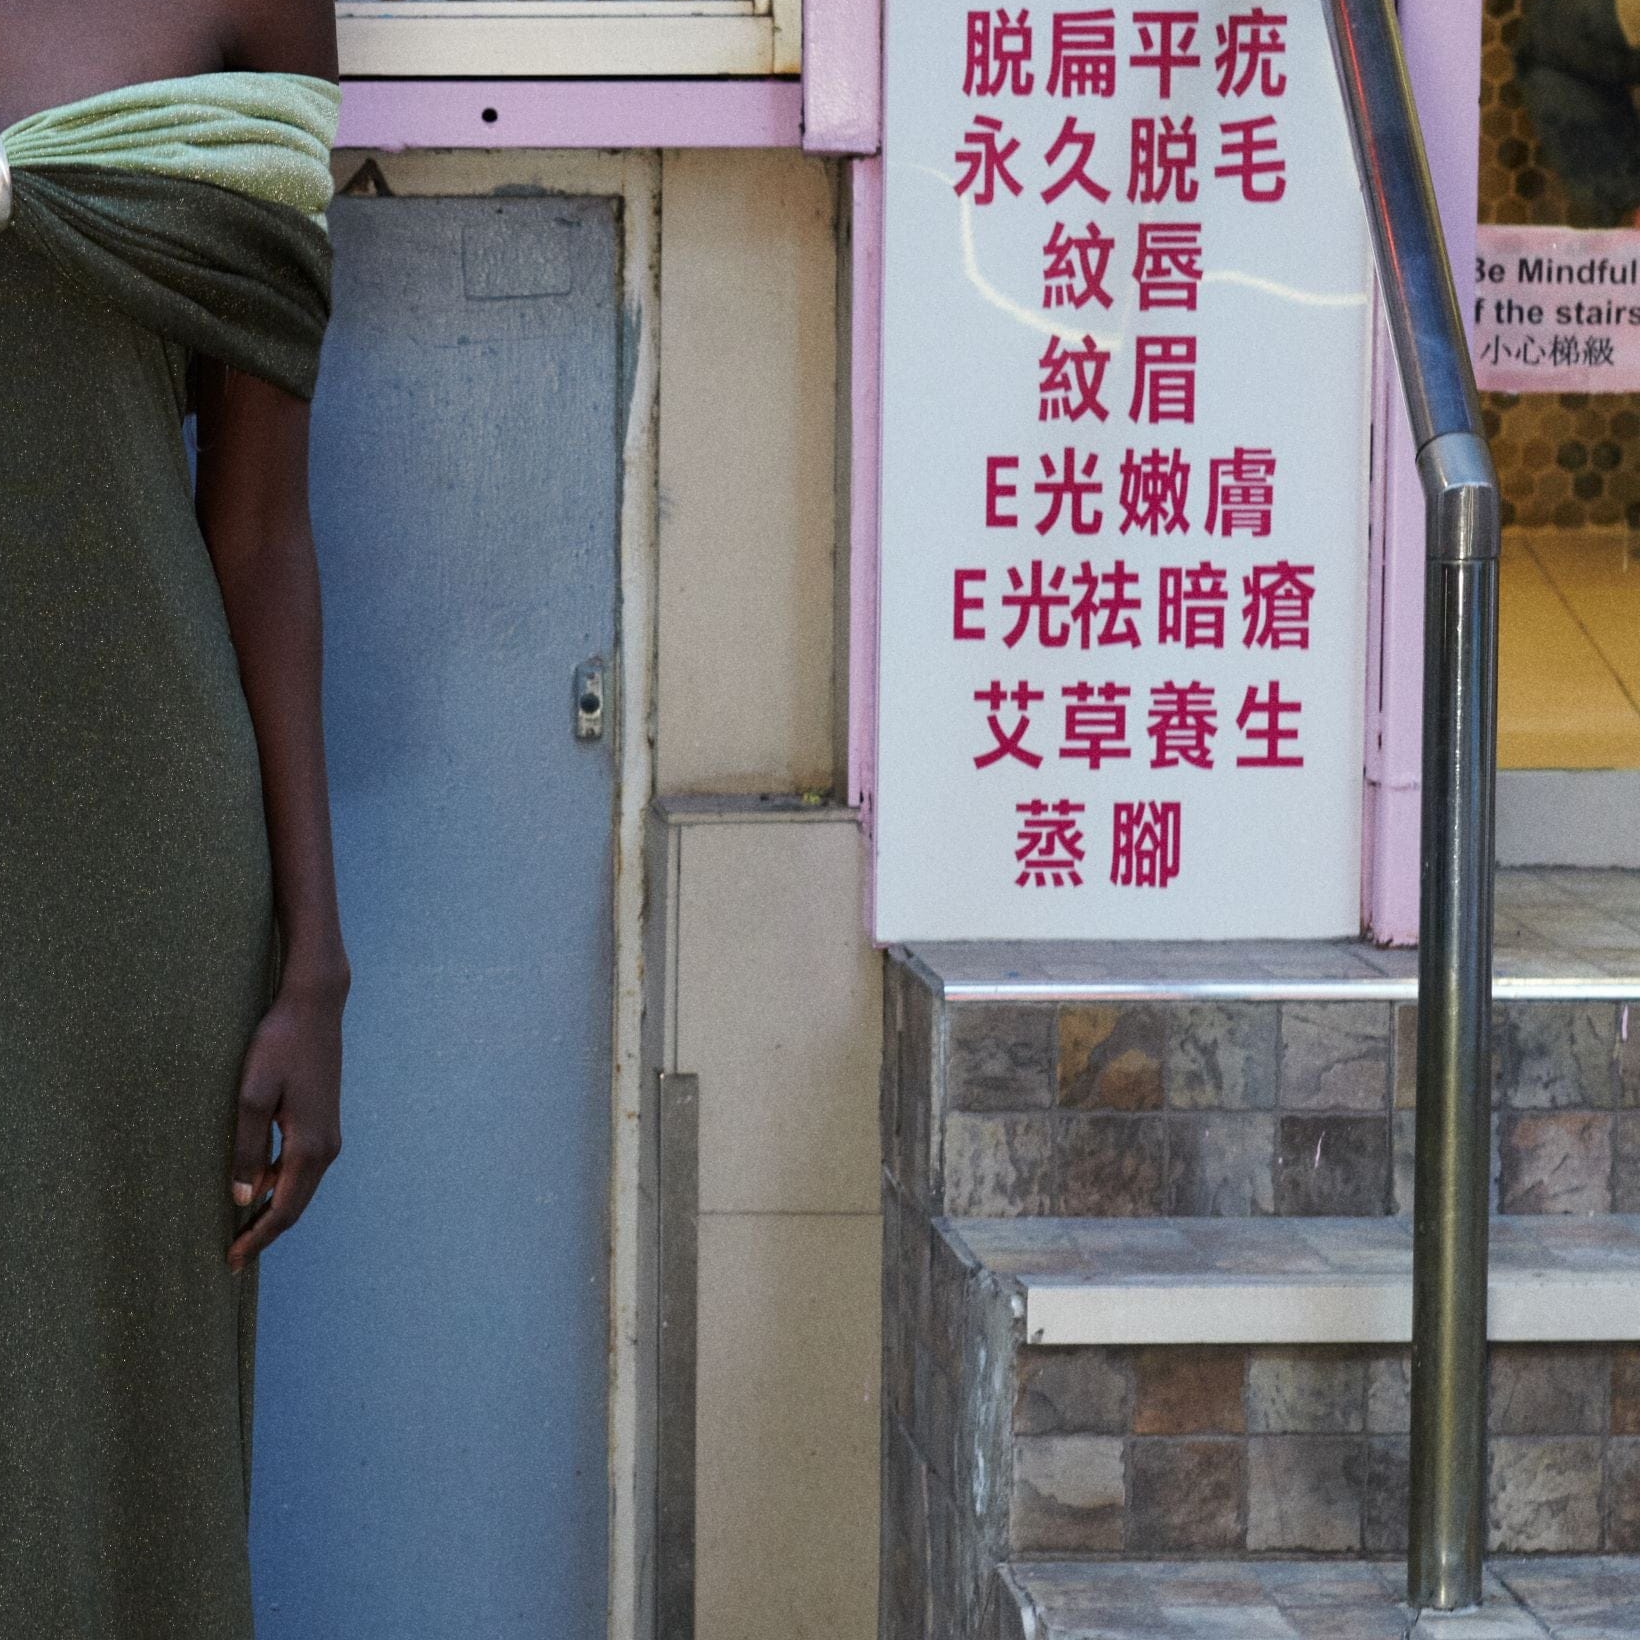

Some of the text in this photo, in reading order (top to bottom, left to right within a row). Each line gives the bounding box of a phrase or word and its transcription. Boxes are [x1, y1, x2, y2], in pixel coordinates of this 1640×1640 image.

[1043, 222, 1203, 311] 紋唇
[1517, 257, 1637, 285] Mindful
[1494, 298, 1544, 325] the
[1555, 299, 1640, 326] stairs
[1039, 335, 1197, 424] 紋眉
[974, 680, 1304, 770] 艾草養生
[1015, 799, 1181, 888] 蒸腳
